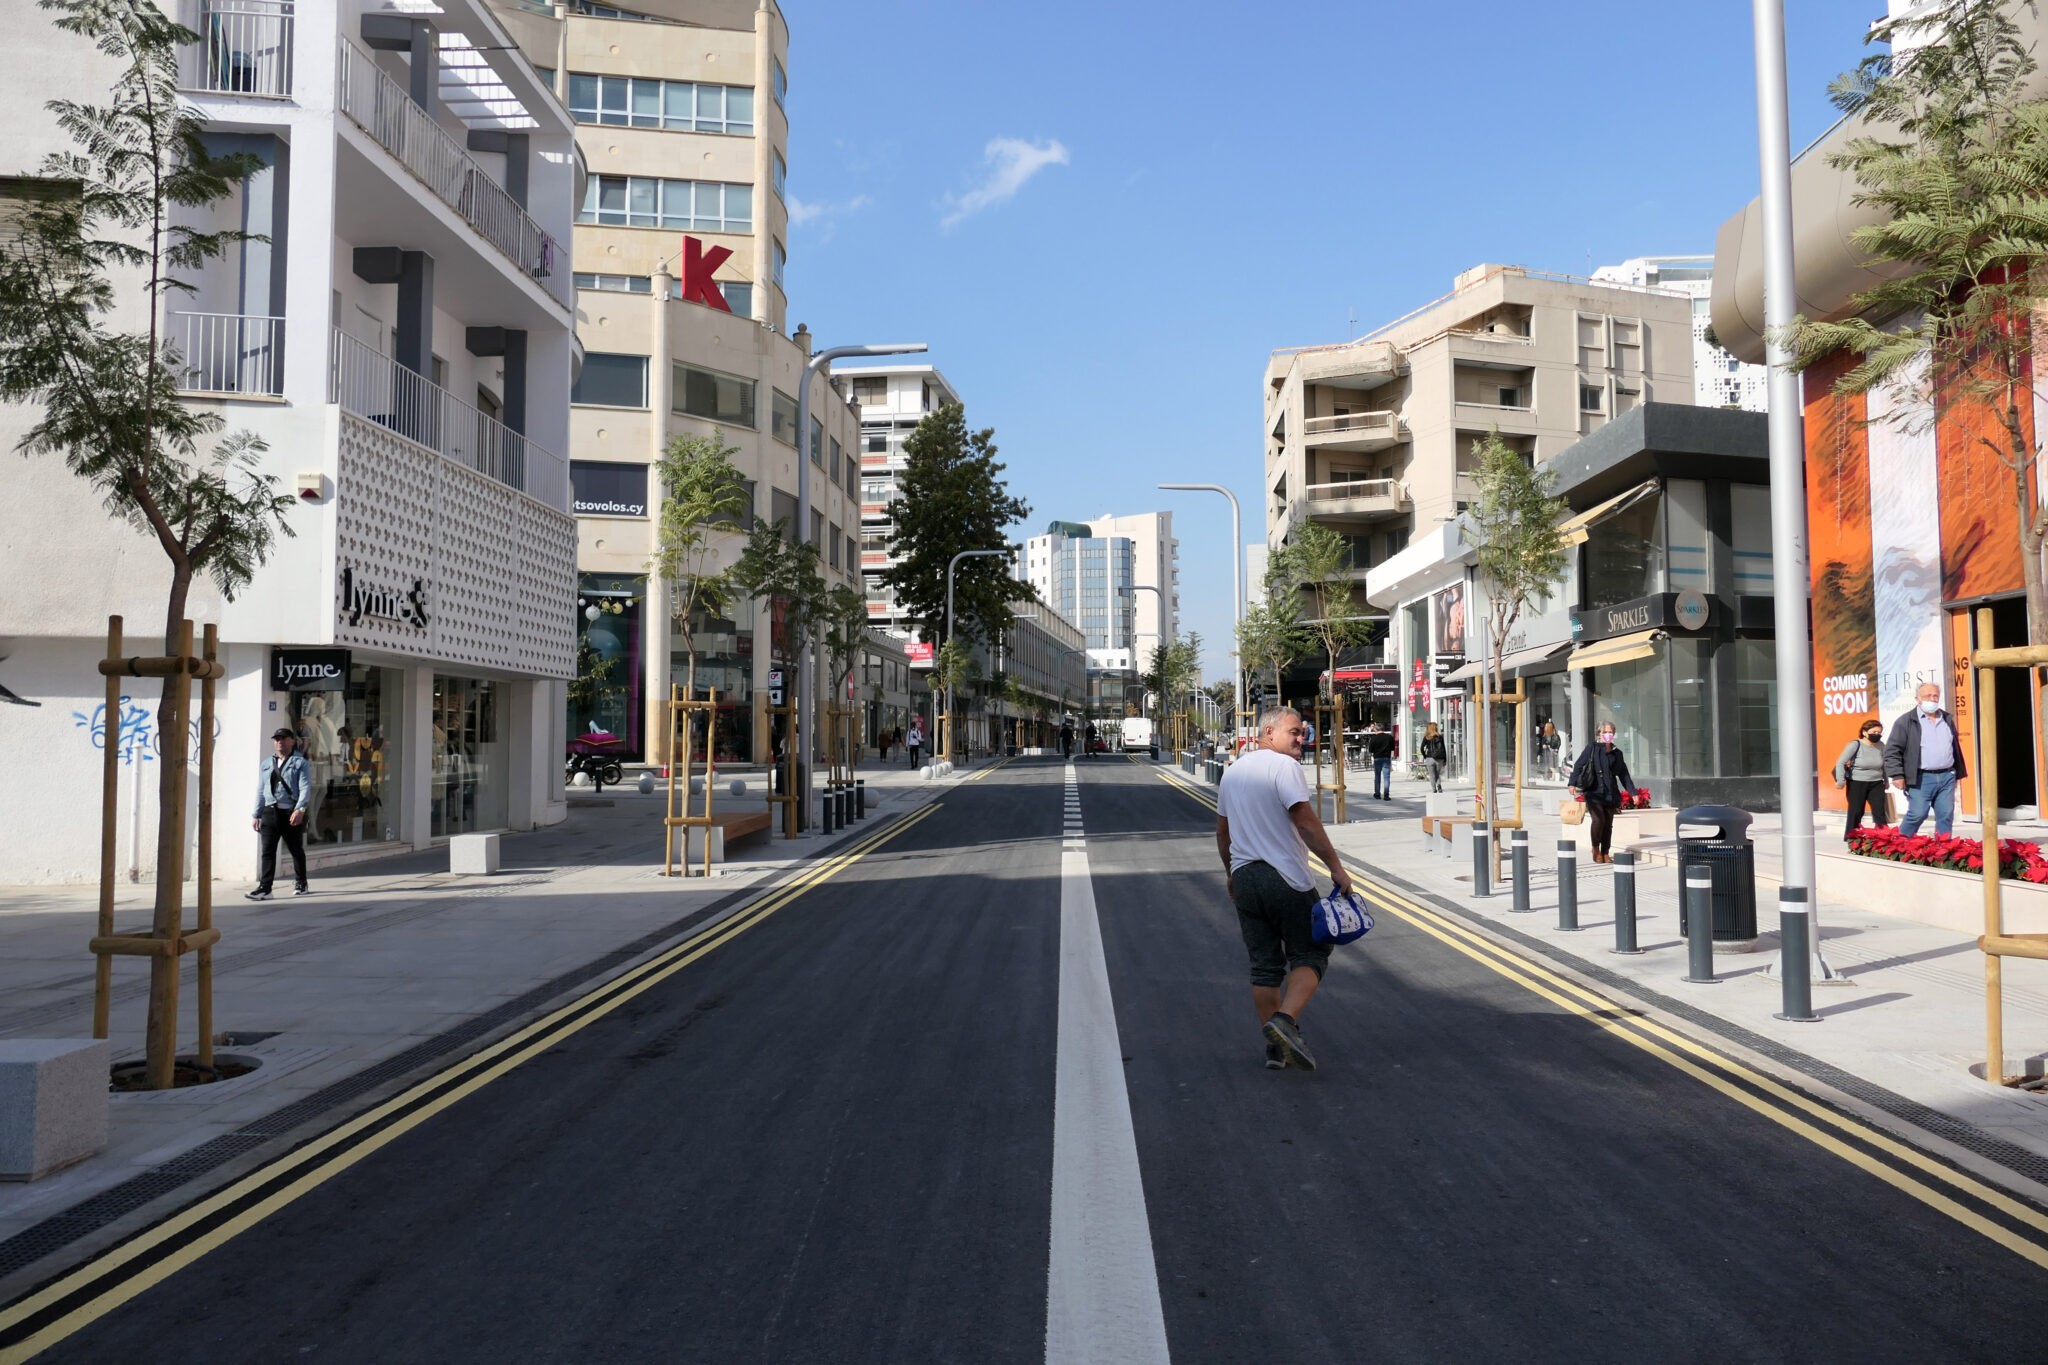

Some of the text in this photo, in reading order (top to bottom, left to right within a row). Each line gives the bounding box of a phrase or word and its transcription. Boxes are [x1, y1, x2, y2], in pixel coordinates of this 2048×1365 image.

[682, 235, 734, 313] K
[573, 500, 644, 515] tsovolos.cy
[342, 567, 414, 627] lynne
[1607, 606, 1648, 633] SPARKLES
[278, 656, 341, 684] lynne
[1823, 673, 1868, 692] COMING
[1823, 691, 1869, 715] SOON
